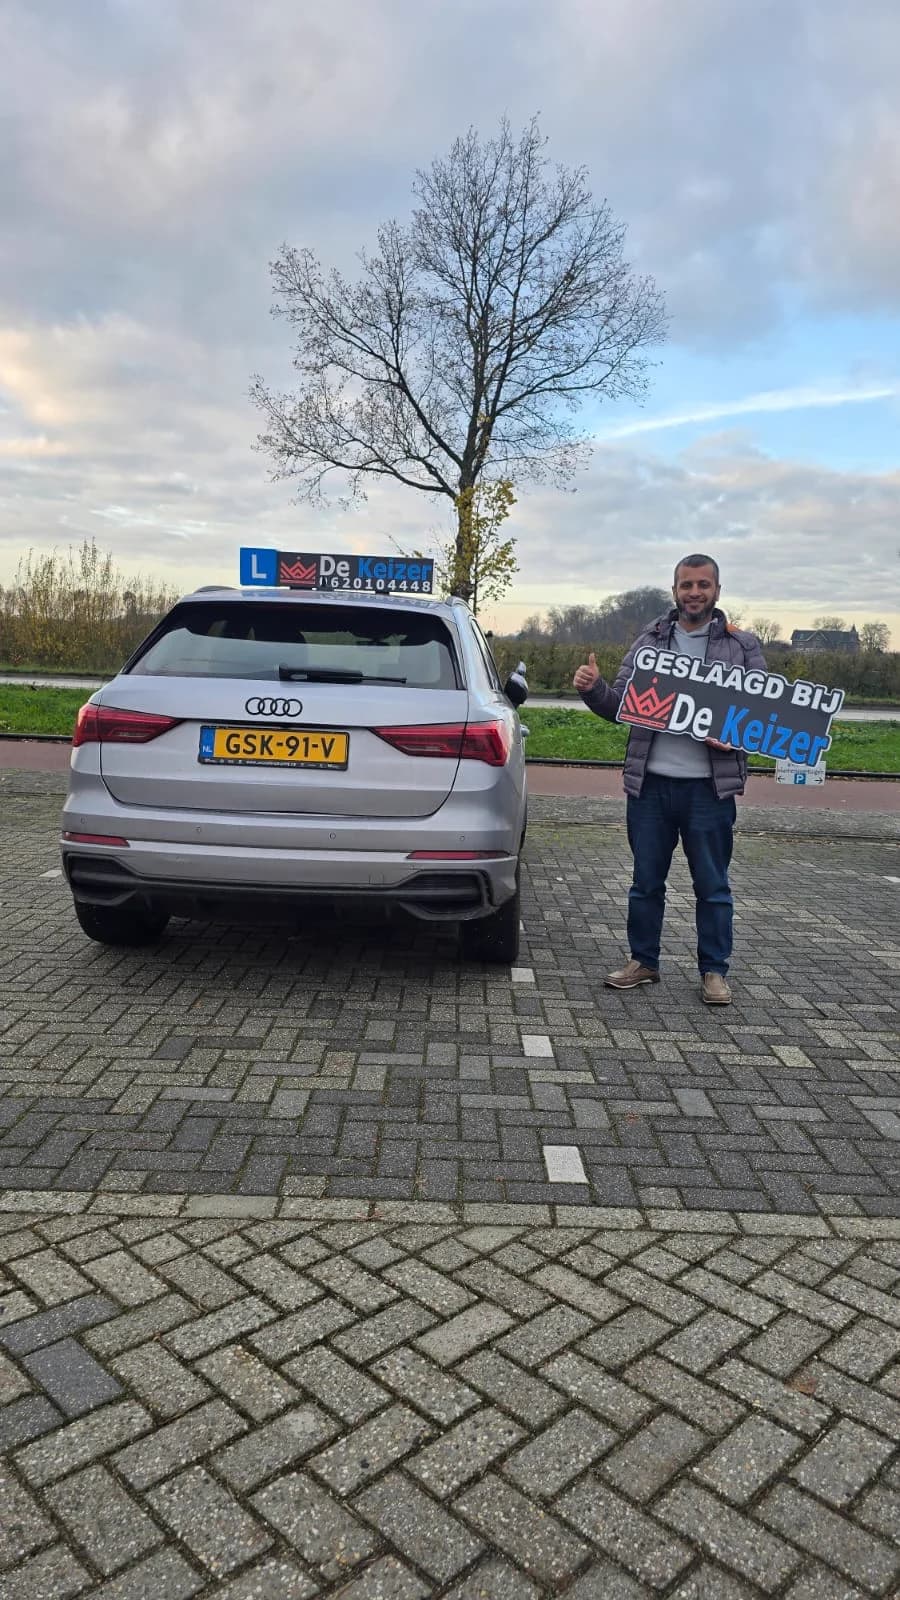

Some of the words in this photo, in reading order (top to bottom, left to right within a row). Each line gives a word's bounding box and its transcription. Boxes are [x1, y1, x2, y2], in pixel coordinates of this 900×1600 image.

[251, 554, 267, 579] L
[319, 555, 350, 577] De
[358, 558, 432, 581] Keizer
[636, 649, 785, 700] GESLAAGD
[791, 683, 841, 714] BIJ
[668, 693, 713, 738] De
[720, 705, 829, 767] Keizer
[202, 745, 213, 754] NL
[225, 733, 336, 758] GSK-91-V
